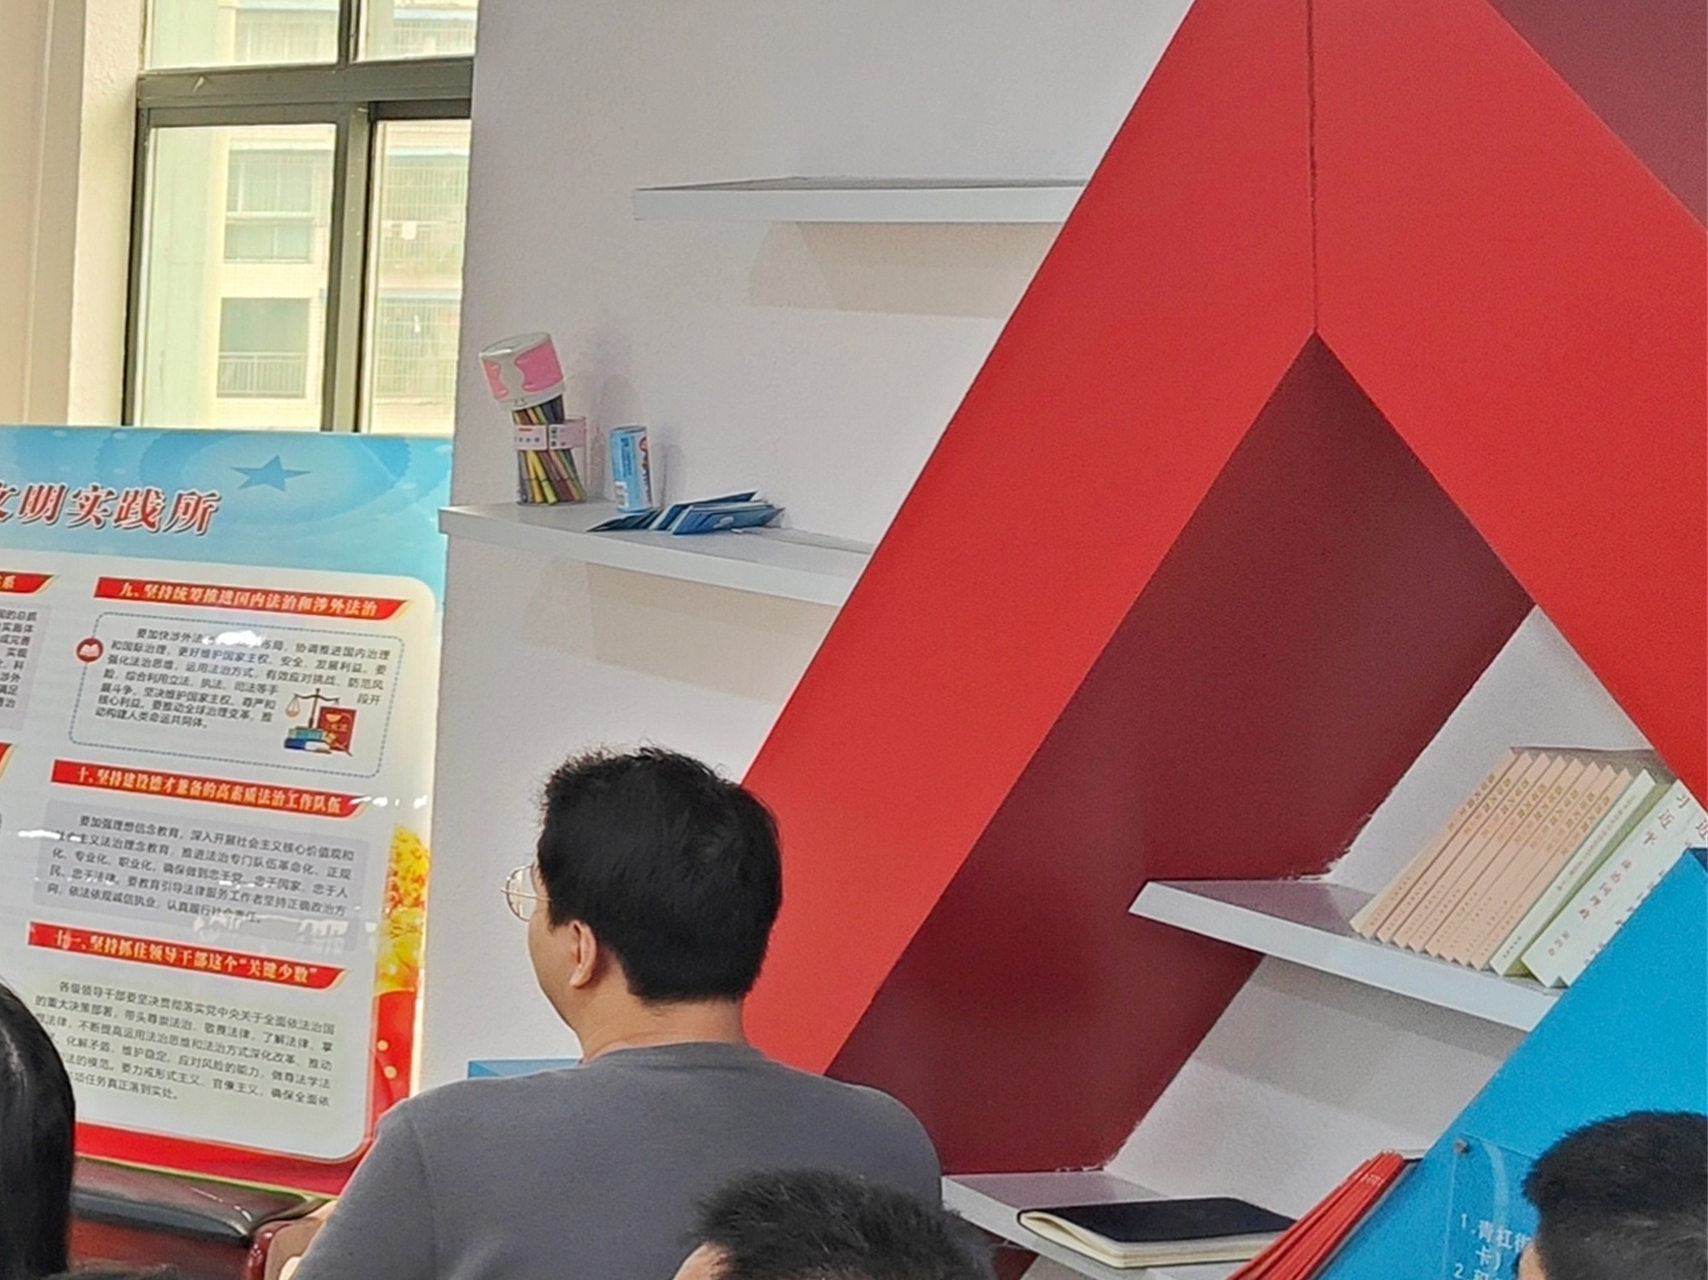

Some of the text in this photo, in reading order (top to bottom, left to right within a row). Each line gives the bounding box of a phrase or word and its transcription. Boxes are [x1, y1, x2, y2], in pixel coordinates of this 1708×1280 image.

[119, 582, 377, 617] 九、坚持统筹推进国内法治和涉外法治
